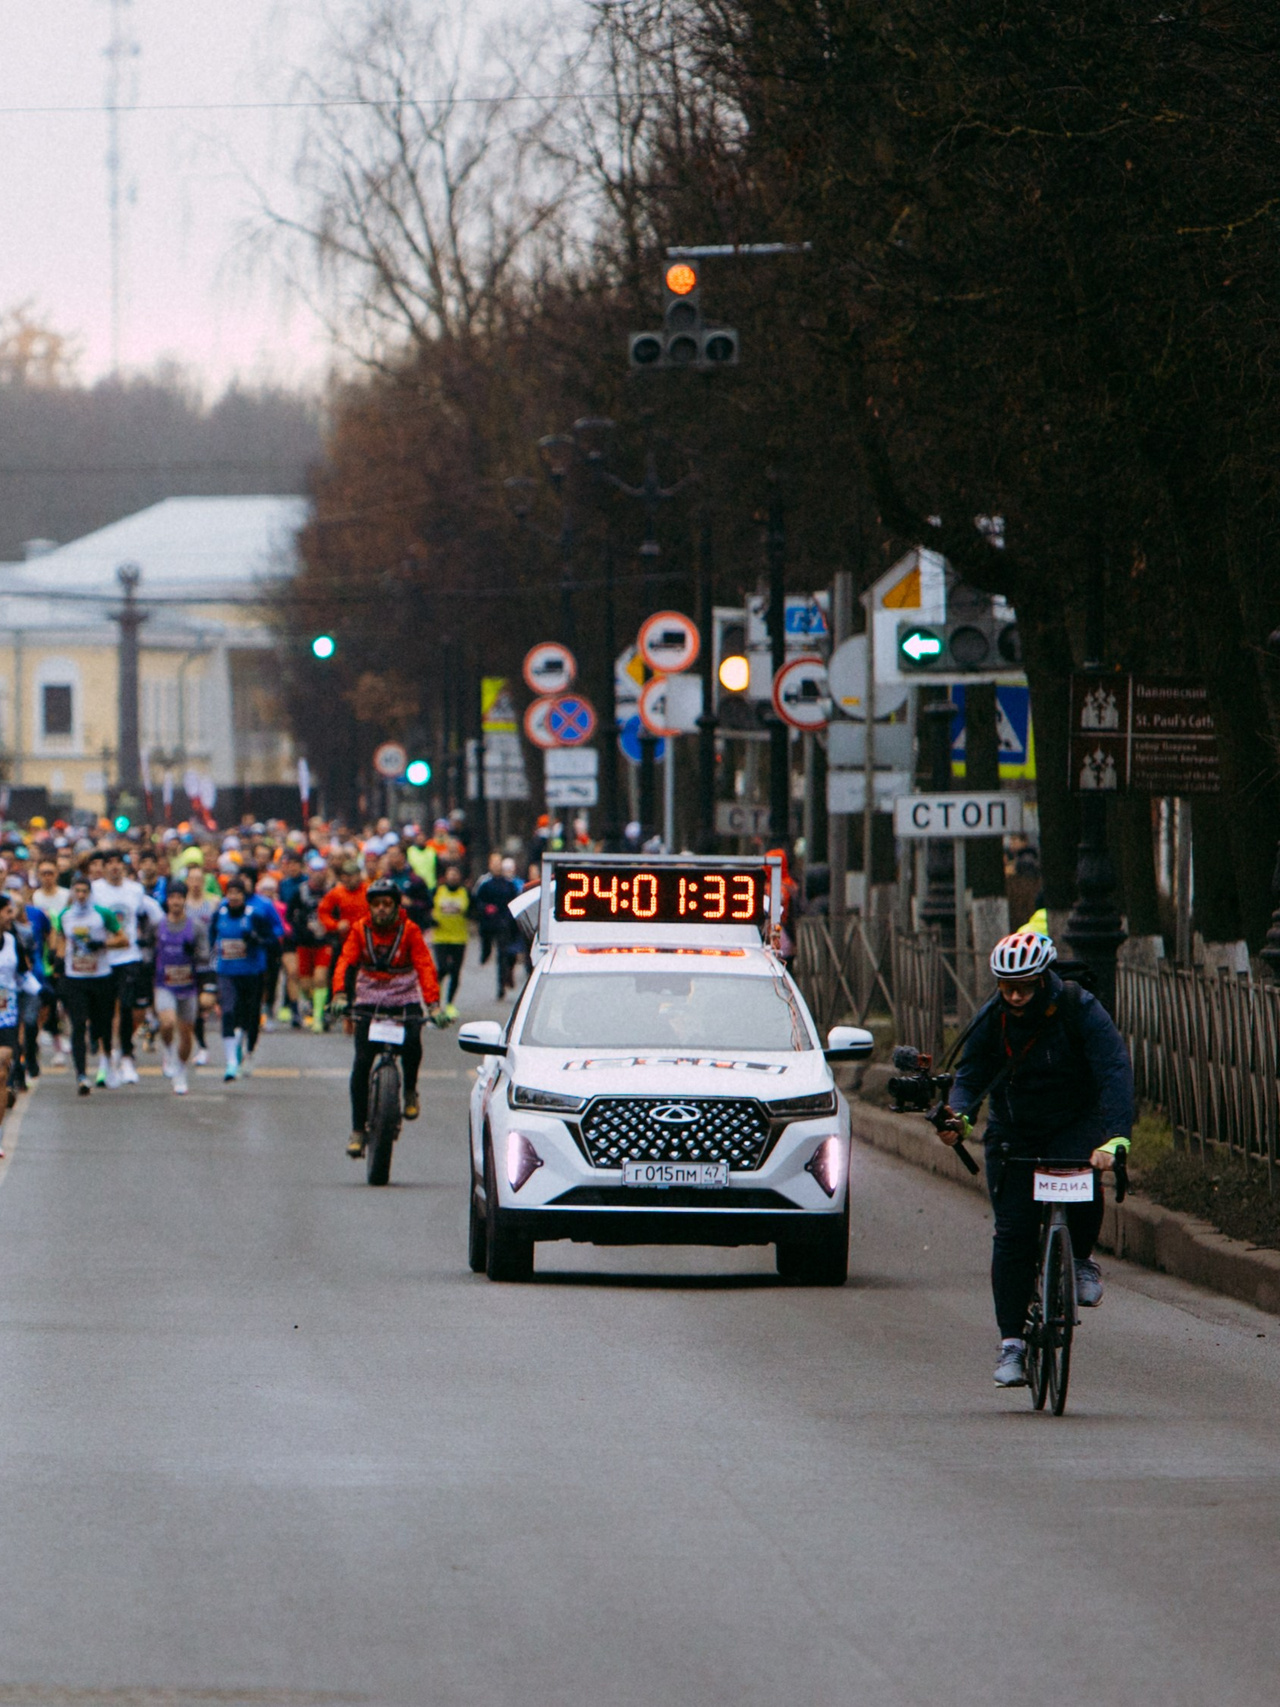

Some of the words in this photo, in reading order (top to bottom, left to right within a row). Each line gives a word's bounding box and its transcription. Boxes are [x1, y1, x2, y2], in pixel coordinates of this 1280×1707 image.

[1153, 714, 1187, 728] Paul's
[728, 809, 766, 833] СТ
[911, 801, 1007, 829] СТОП
[704, 1166, 719, 1179] 47
[1038, 1181, 1089, 1192] МЕДИА
